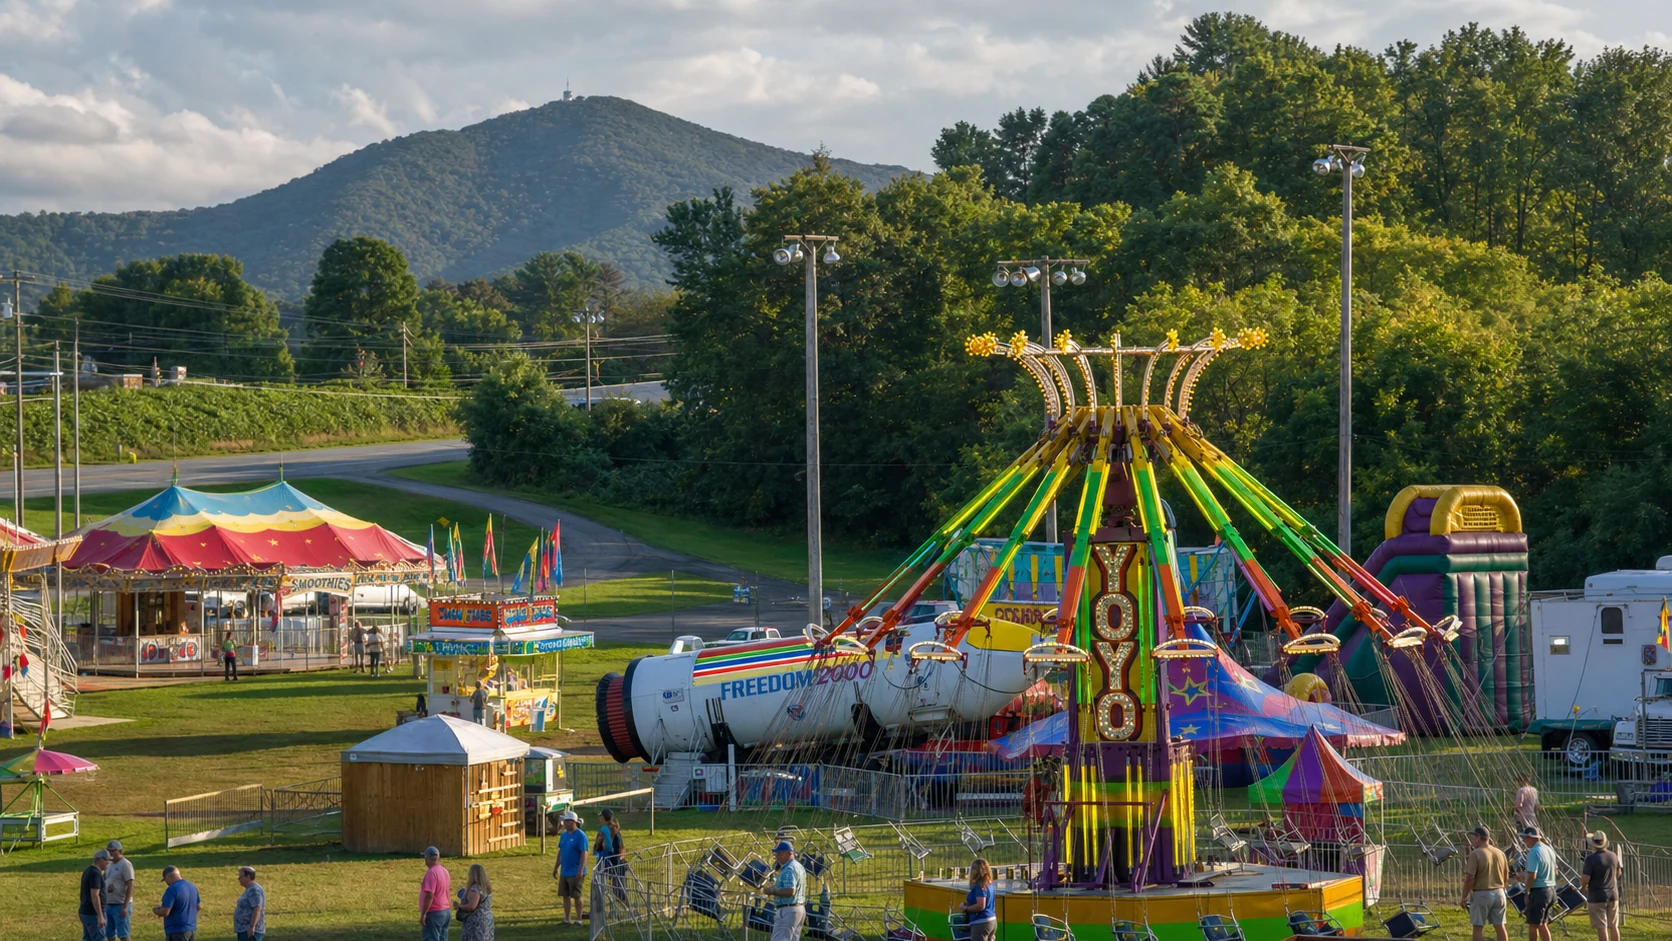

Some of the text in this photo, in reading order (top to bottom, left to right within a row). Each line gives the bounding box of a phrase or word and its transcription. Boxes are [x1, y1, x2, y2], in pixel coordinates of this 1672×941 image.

[291, 577, 352, 592] SMOOTHIES
[1092, 542, 1140, 741] YOYO
[720, 660, 874, 700] FREEDOM 2000
